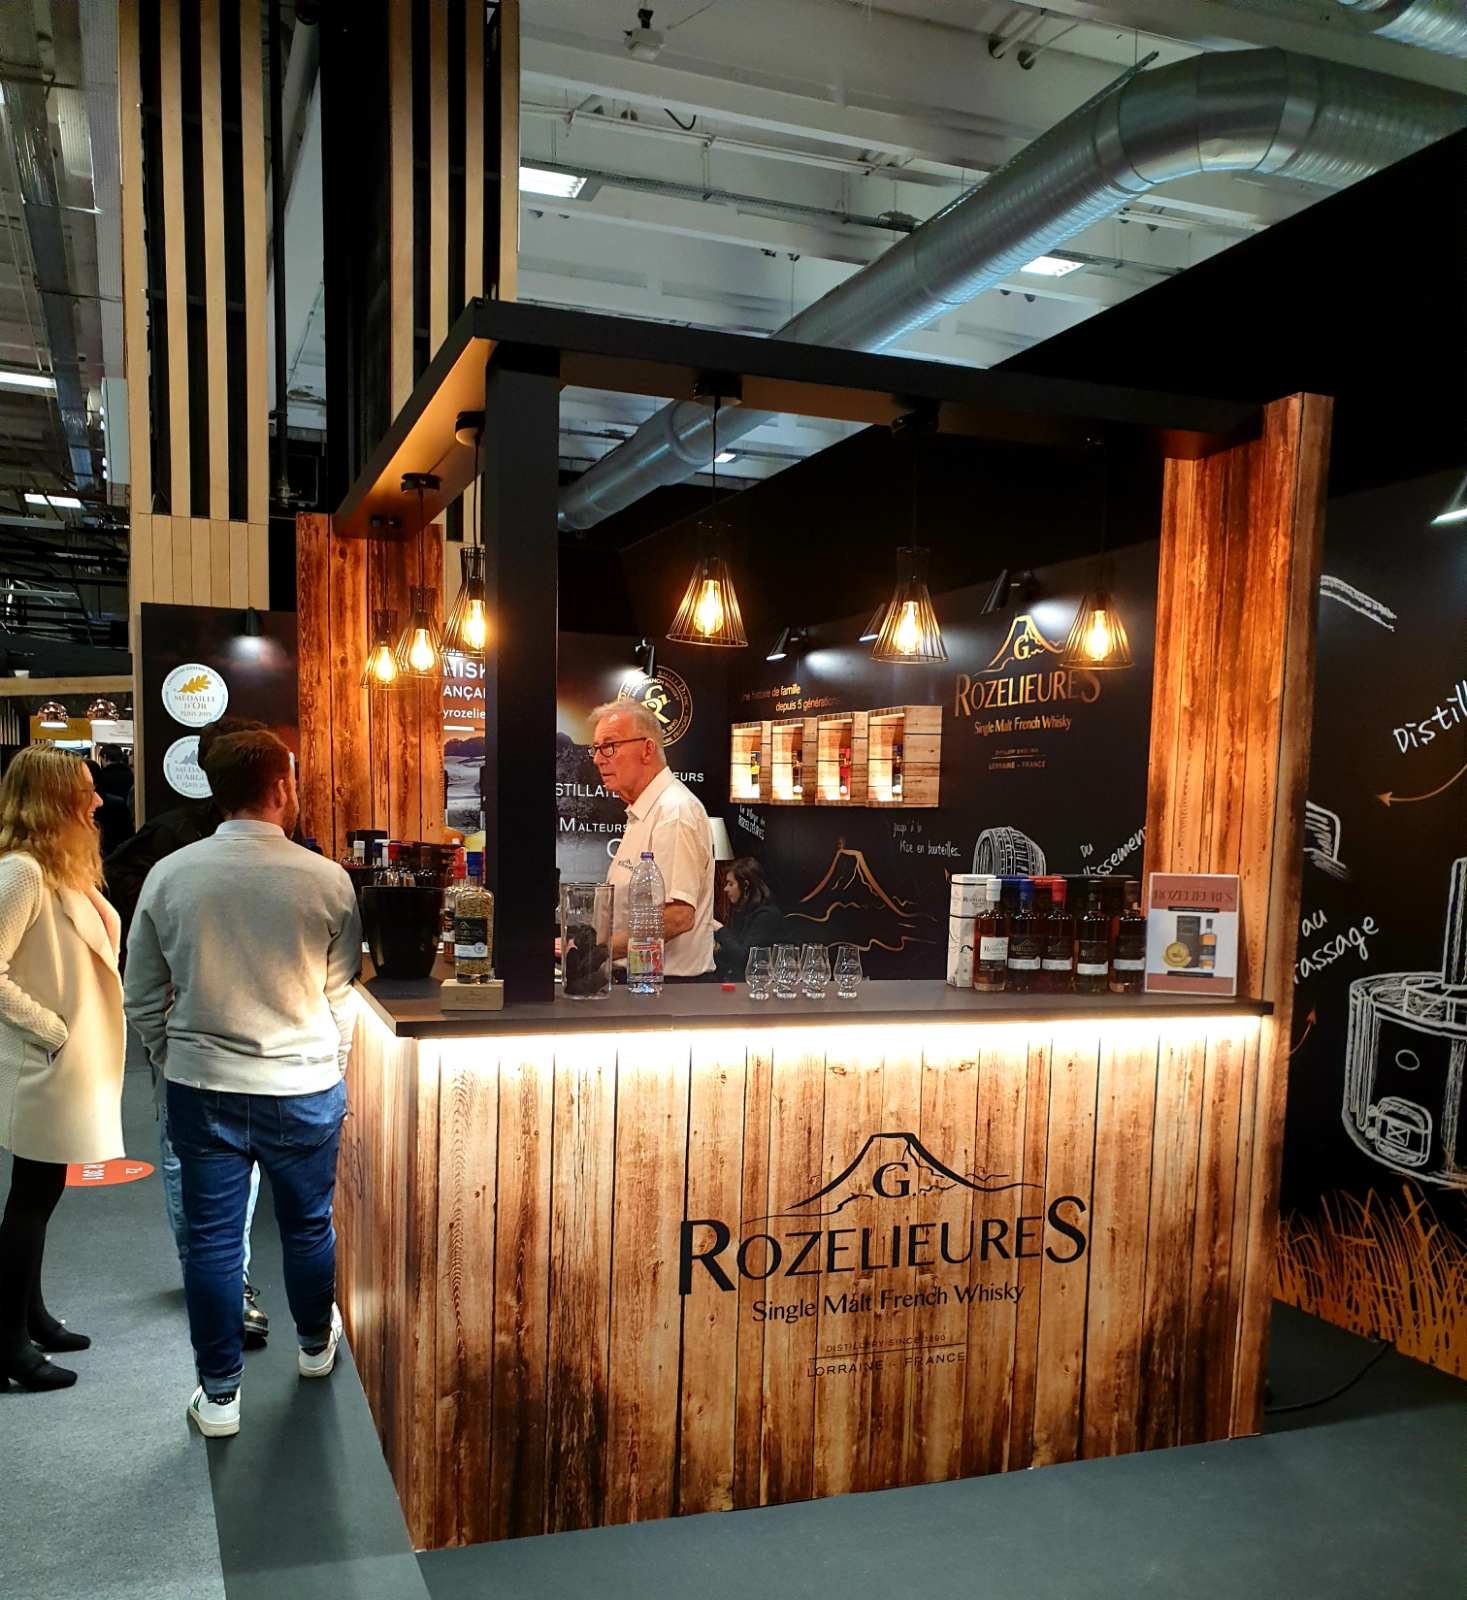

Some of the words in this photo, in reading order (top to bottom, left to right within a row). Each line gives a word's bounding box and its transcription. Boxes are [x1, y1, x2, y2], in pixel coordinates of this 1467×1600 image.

[954, 668, 1101, 717] ROZELIEURES
[775, 700, 796, 714] depuis
[995, 719, 1013, 733] Malt
[1014, 716, 1041, 731] French
[1041, 714, 1072, 731] Whisky
[1302, 909, 1328, 937] au
[678, 1195, 1087, 1296] ROZELIEURES
[752, 1299, 816, 1324] Single
[823, 1292, 872, 1315] Malt
[880, 1285, 948, 1310] French
[954, 1281, 1026, 1304] Whisky
[807, 1359, 883, 1378] LORRAINE
[904, 1351, 967, 1368] FRANCE
